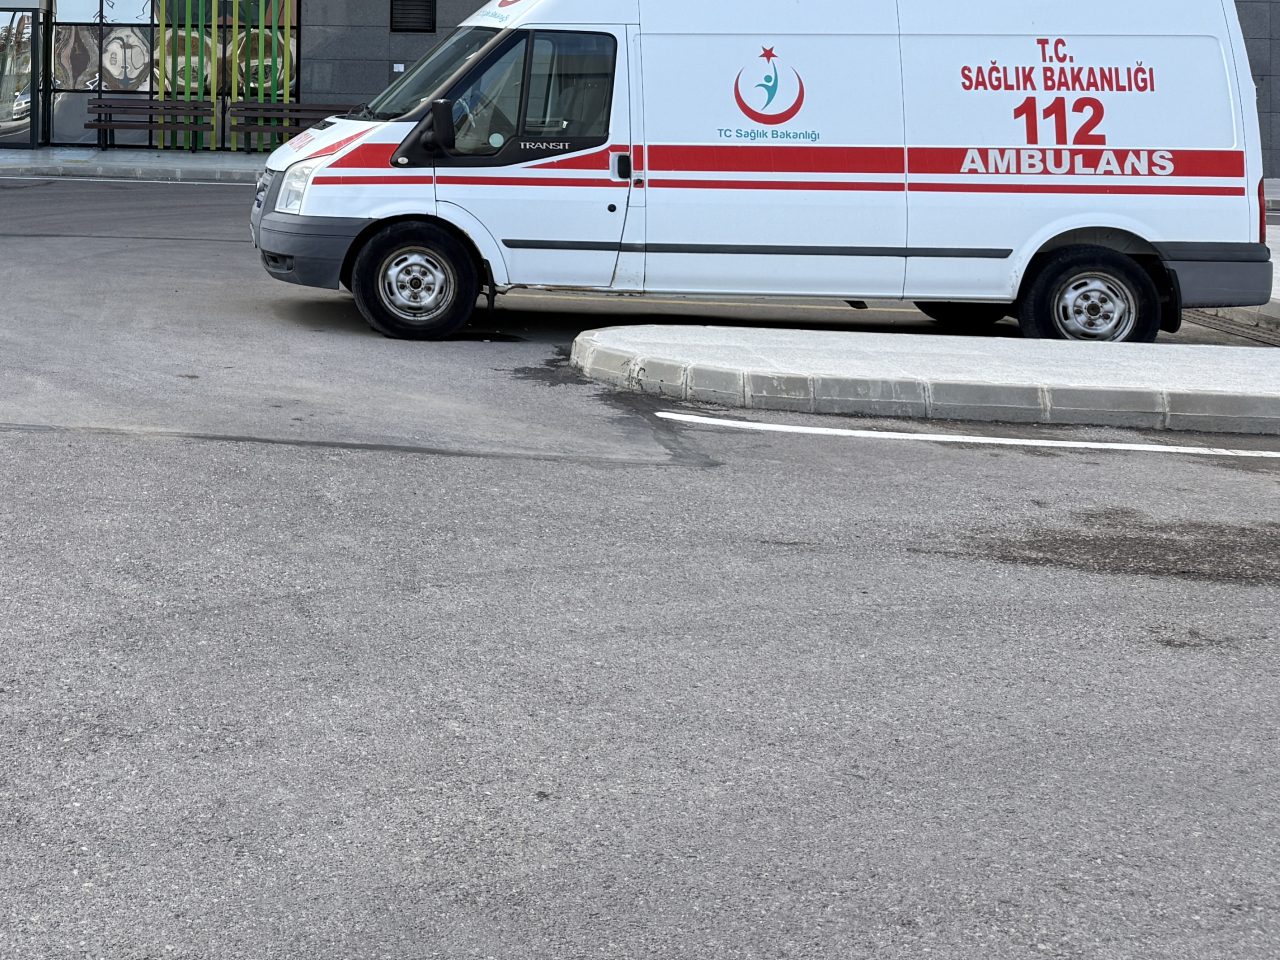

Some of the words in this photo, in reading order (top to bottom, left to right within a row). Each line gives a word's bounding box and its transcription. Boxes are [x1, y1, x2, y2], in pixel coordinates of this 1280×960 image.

[1036, 38, 1074, 63] T.C.
[960, 59, 1037, 91] SAĞLIK
[1042, 60, 1155, 92] BAKANLIĞI
[1013, 96, 1107, 146] 112
[519, 141, 571, 150] TRANSIT
[717, 128, 732, 138] TC
[735, 128, 768, 141] Sağlık
[771, 129, 820, 142] Bakanlığı
[960, 148, 1175, 176] AMBULANS
